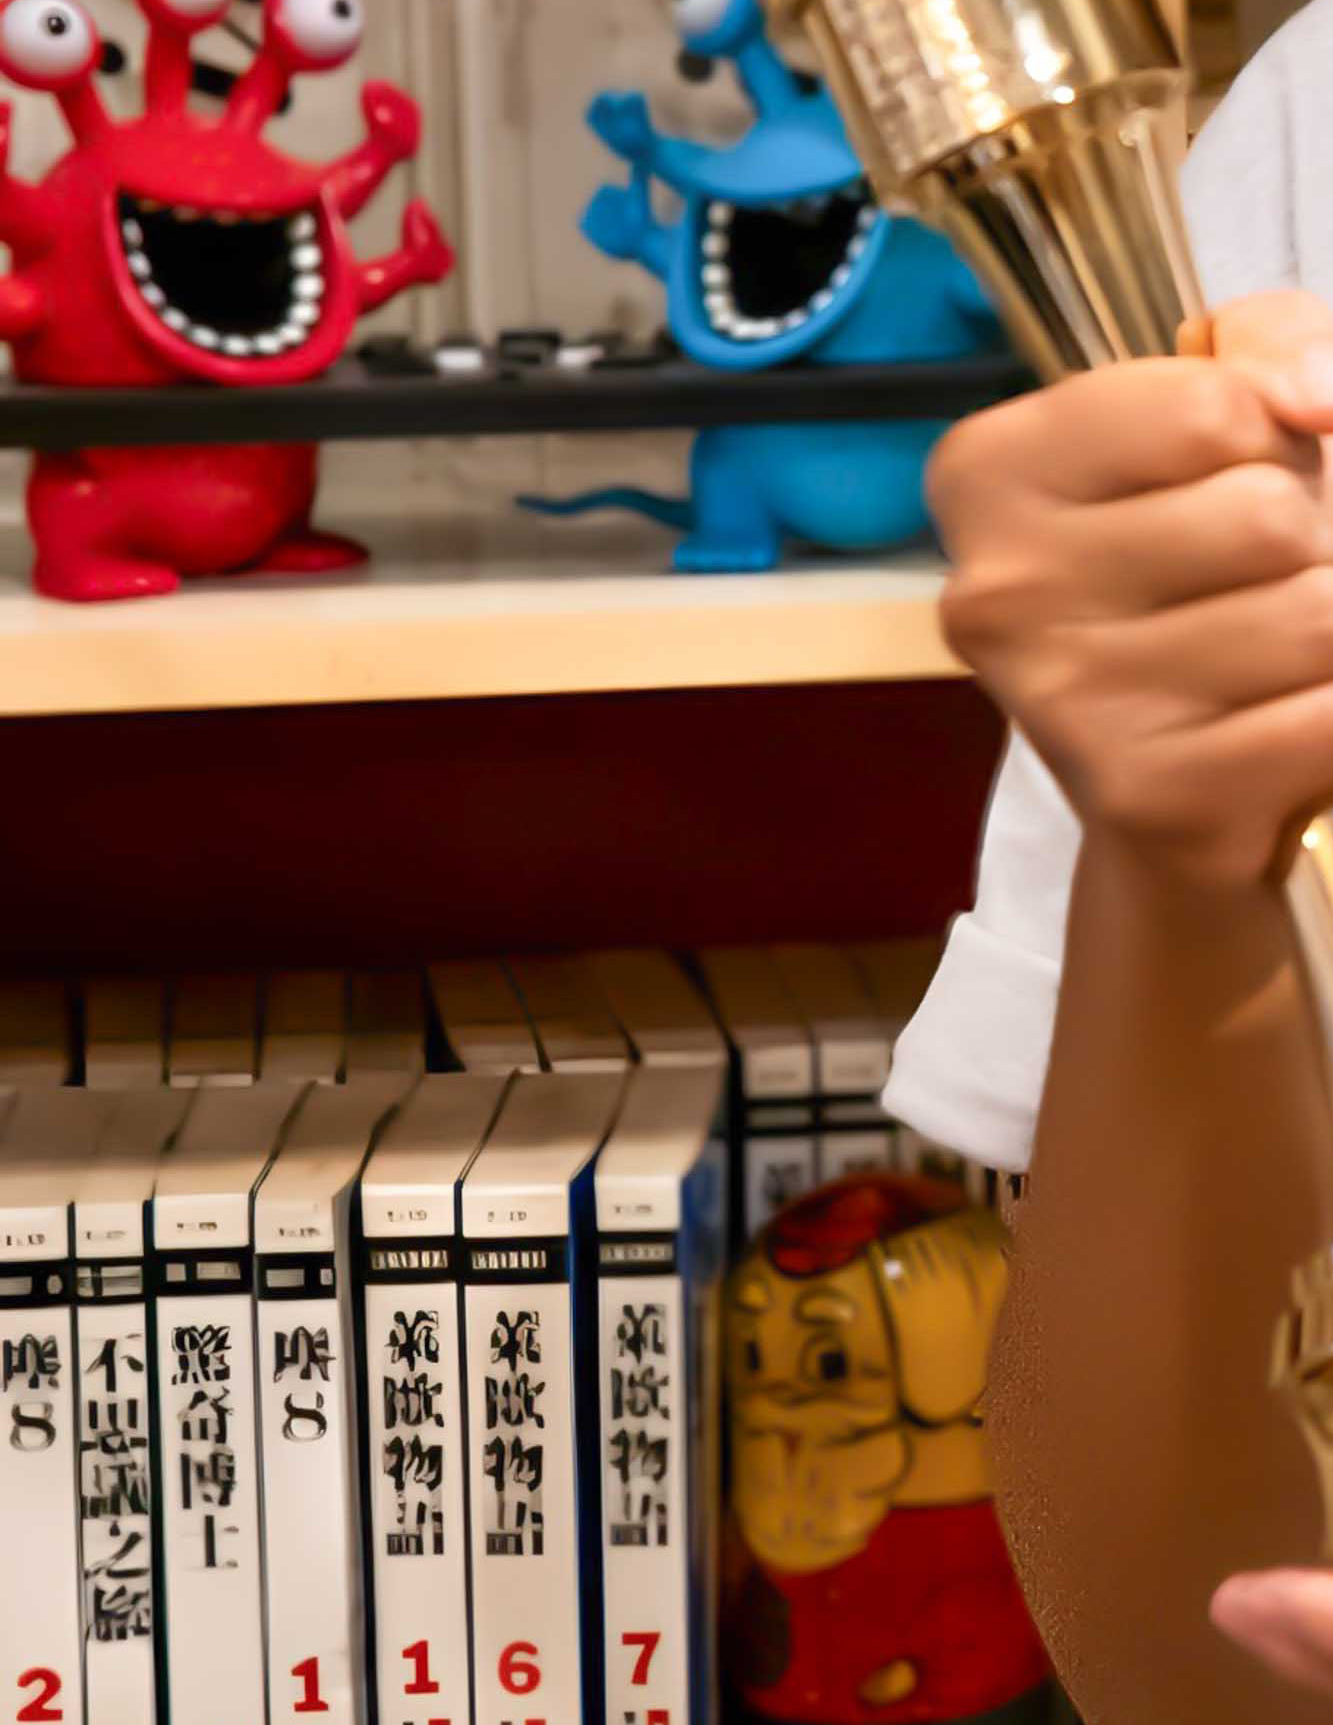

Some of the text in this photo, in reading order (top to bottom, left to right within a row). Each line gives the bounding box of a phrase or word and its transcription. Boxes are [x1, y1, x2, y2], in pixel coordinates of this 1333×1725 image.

[291, 1657, 329, 1712] 1
[402, 1640, 439, 1694] 1
[497, 1641, 541, 1695] 6
[622, 1632, 661, 1685] 7
[16, 1666, 64, 1722] 2
